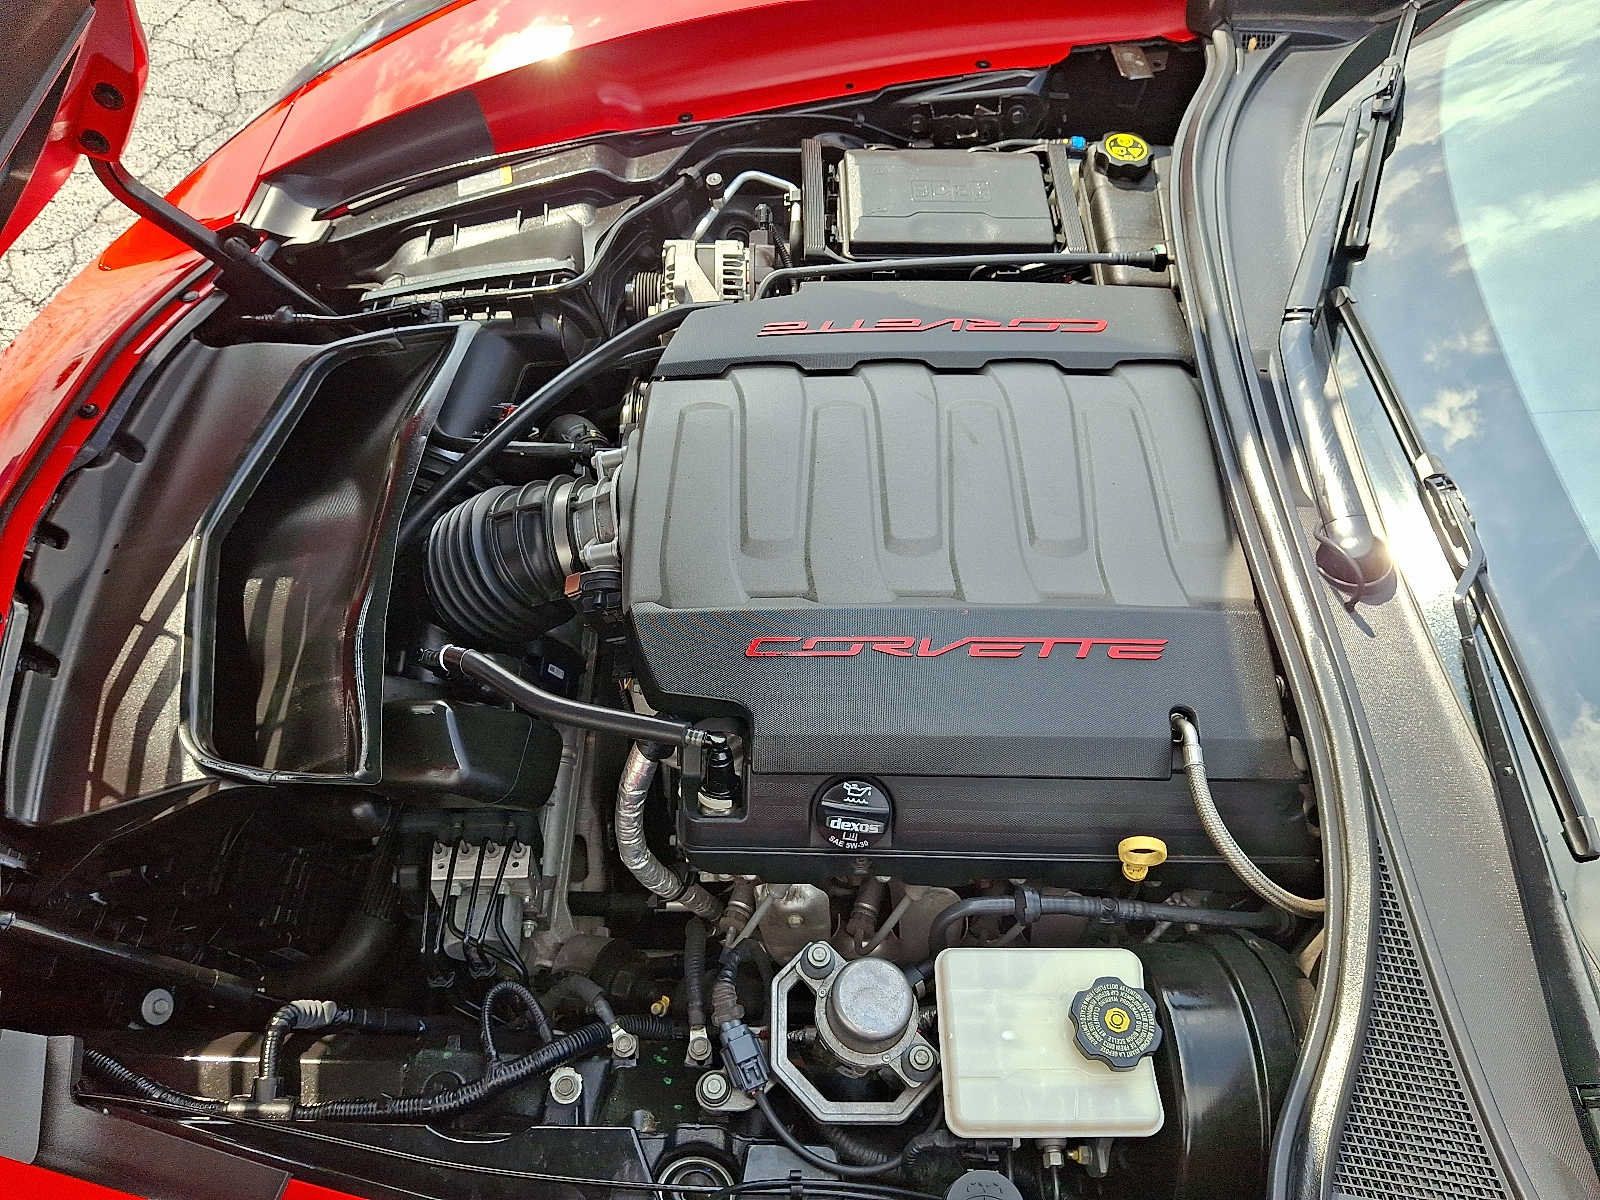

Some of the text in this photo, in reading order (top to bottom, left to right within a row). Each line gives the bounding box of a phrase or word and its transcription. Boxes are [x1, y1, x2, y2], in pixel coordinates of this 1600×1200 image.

[756, 318, 1108, 337] CORVETTE
[745, 636, 1168, 660] CORVETTE
[830, 817, 880, 833] dexos
[829, 835, 869, 849] SAE 5W-30
